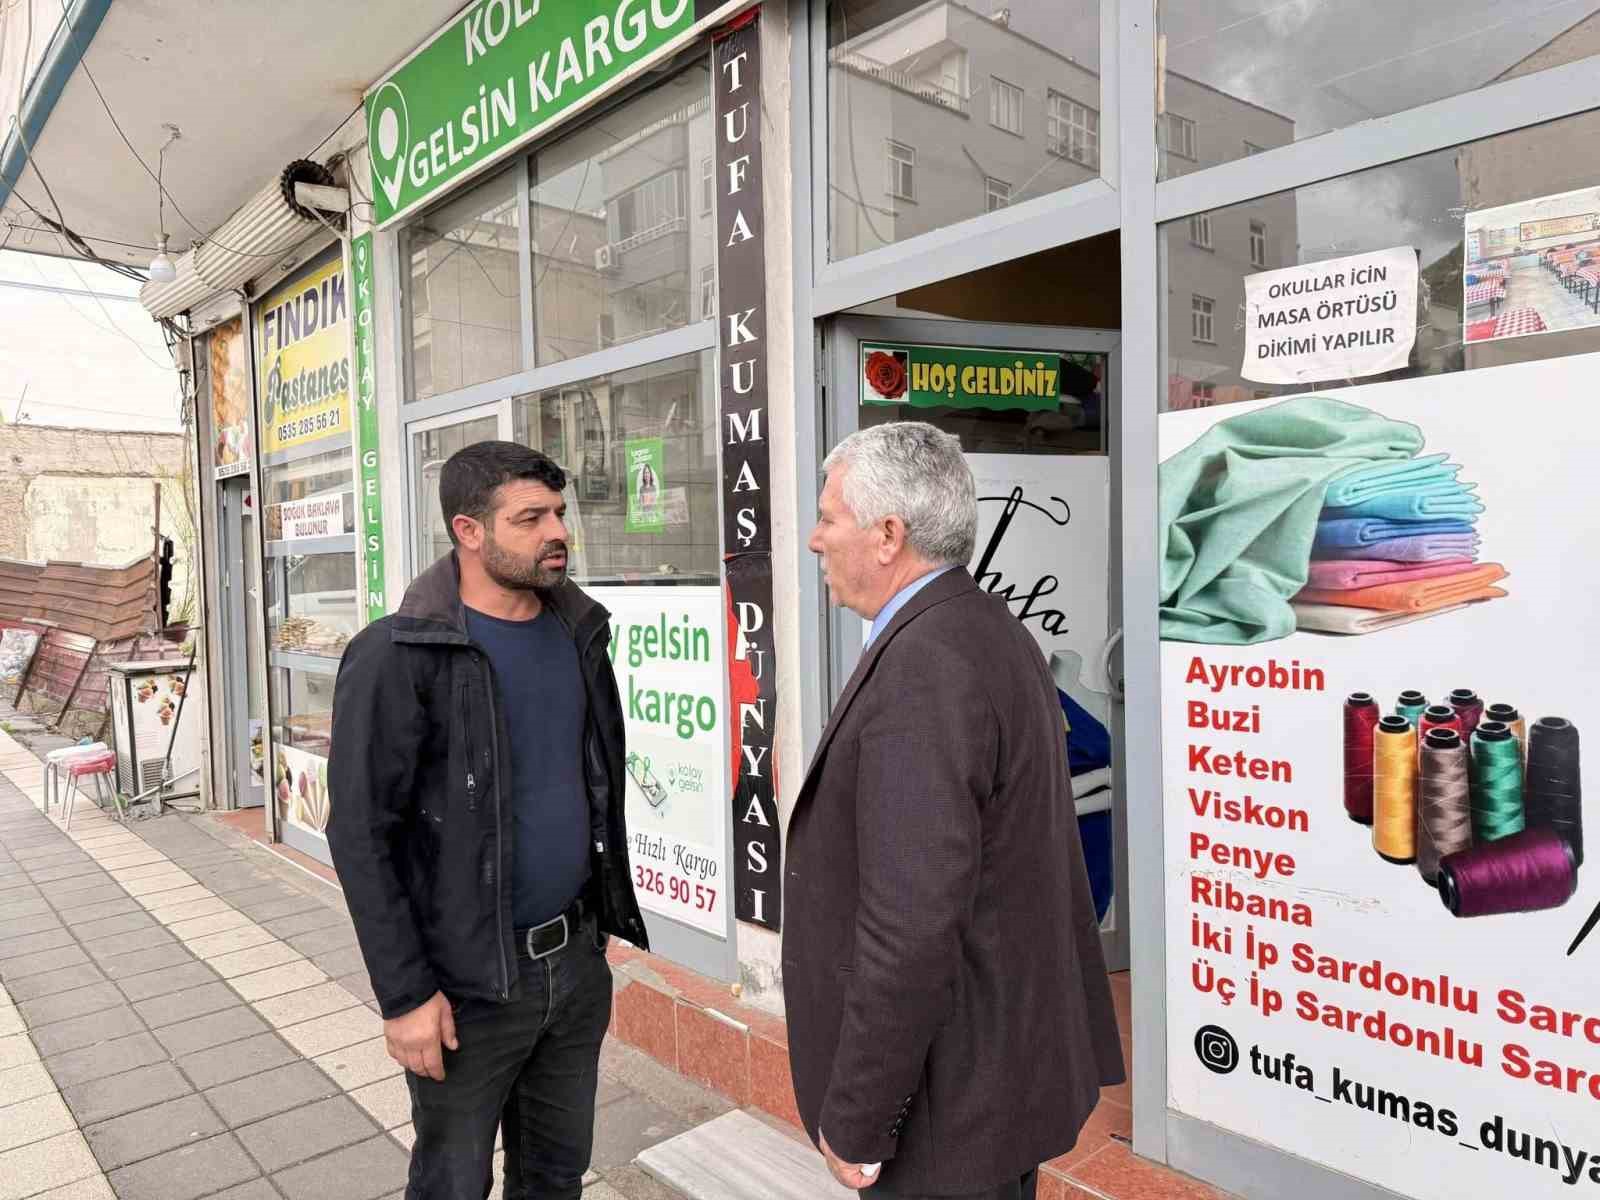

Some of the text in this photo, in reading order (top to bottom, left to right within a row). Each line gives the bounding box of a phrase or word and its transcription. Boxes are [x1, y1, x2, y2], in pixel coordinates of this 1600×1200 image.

[464, 0, 540, 66] KOL
[408, 0, 687, 187] GELSİN KARGO
[722, 52, 755, 248] TUFA
[1257, 290, 1397, 330] MASA ÖRTÜSÜ
[1268, 273, 1345, 299] OKULLAR
[263, 271, 346, 357] FINDIK
[1257, 326, 1395, 359] DİKİMİ YAPILIR
[911, 360, 1058, 398] HOŞ GELDİNİZ
[278, 407, 340, 441] 0535 285 56 21
[358, 278, 384, 608] KOLAY GELSİN
[726, 308, 764, 547] KUMAŞ
[628, 612, 710, 668] gelsin
[1185, 656, 1326, 693] Ayrobin
[628, 674, 716, 739] kargo
[1188, 700, 1261, 733] Buzi
[1188, 744, 1293, 783] Keten
[1188, 788, 1309, 832] Viskon
[635, 832, 667, 862] Hızlı
[673, 844, 717, 881] Kargo
[1190, 831, 1297, 880] Penye
[635, 865, 717, 913] 326 90 57
[1191, 875, 1313, 927] Ribana
[1191, 912, 1232, 955] İki
[1246, 925, 1279, 970] İp
[1291, 942, 1478, 1014] Sardonlu
[1192, 958, 1236, 1006] Üç
[1250, 971, 1283, 1017] İp
[1296, 990, 1483, 1067] Sardonlu
